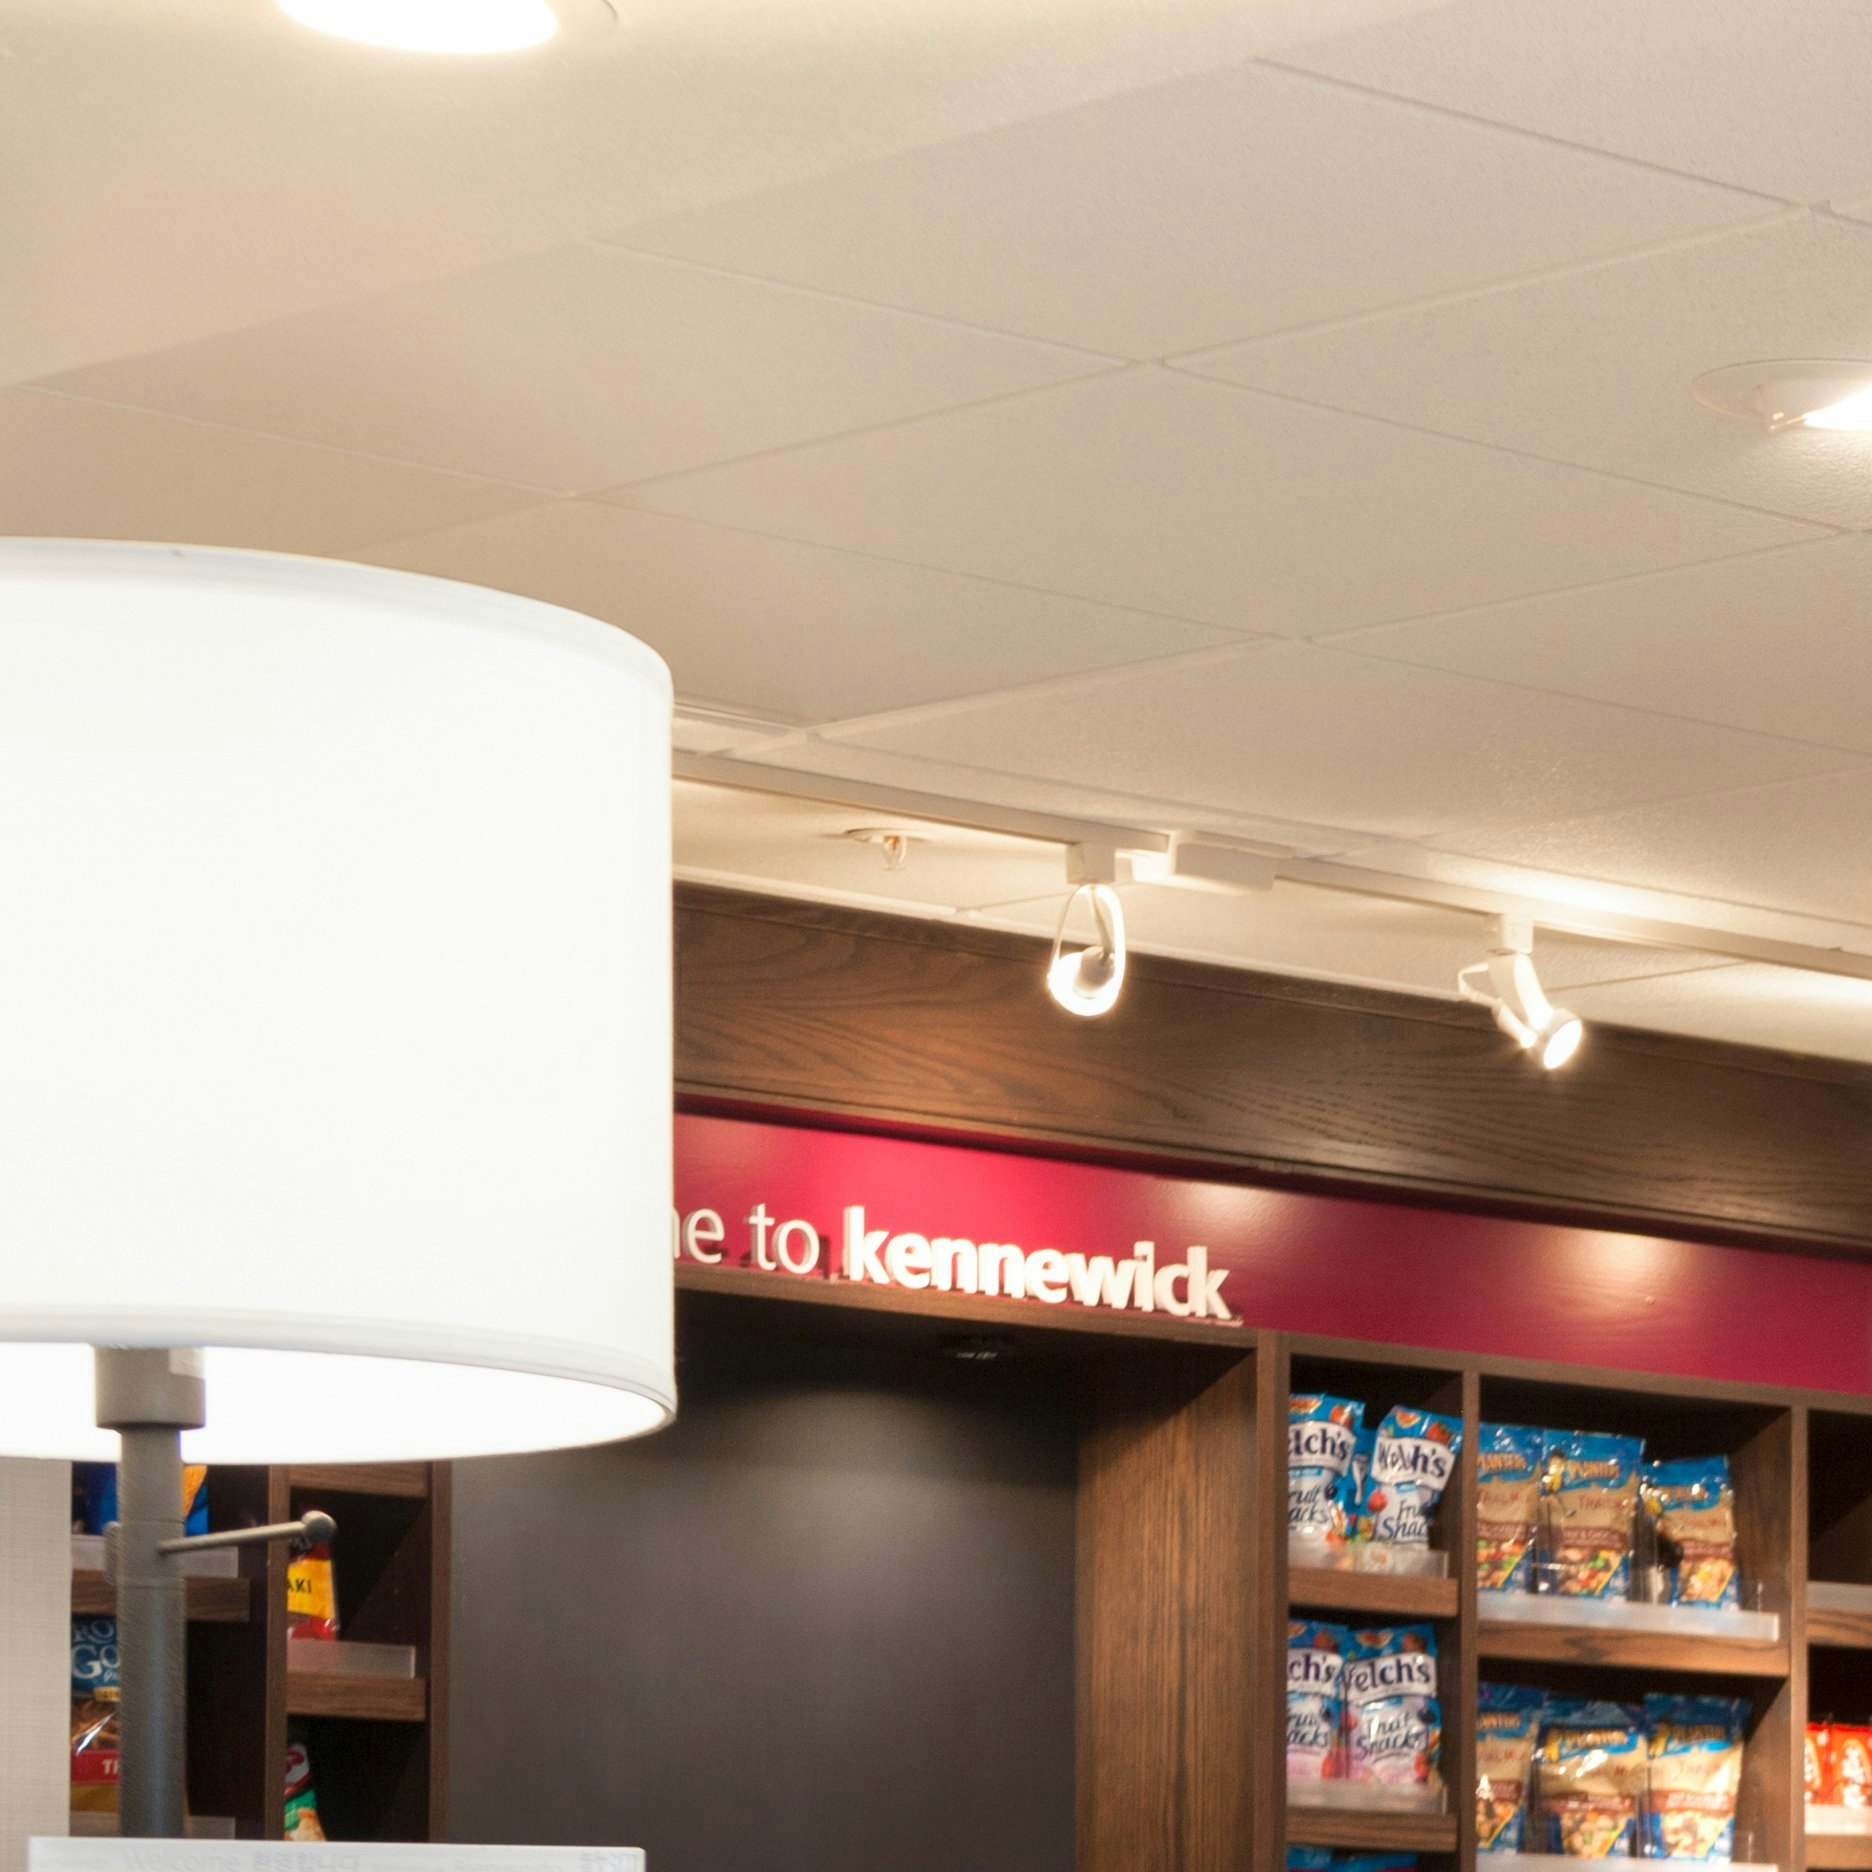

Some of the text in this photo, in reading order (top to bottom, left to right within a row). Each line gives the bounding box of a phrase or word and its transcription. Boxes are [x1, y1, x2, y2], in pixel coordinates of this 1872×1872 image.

[672, 1203, 1233, 1320] e to kennewick
[1289, 1427, 1350, 1461] lch's
